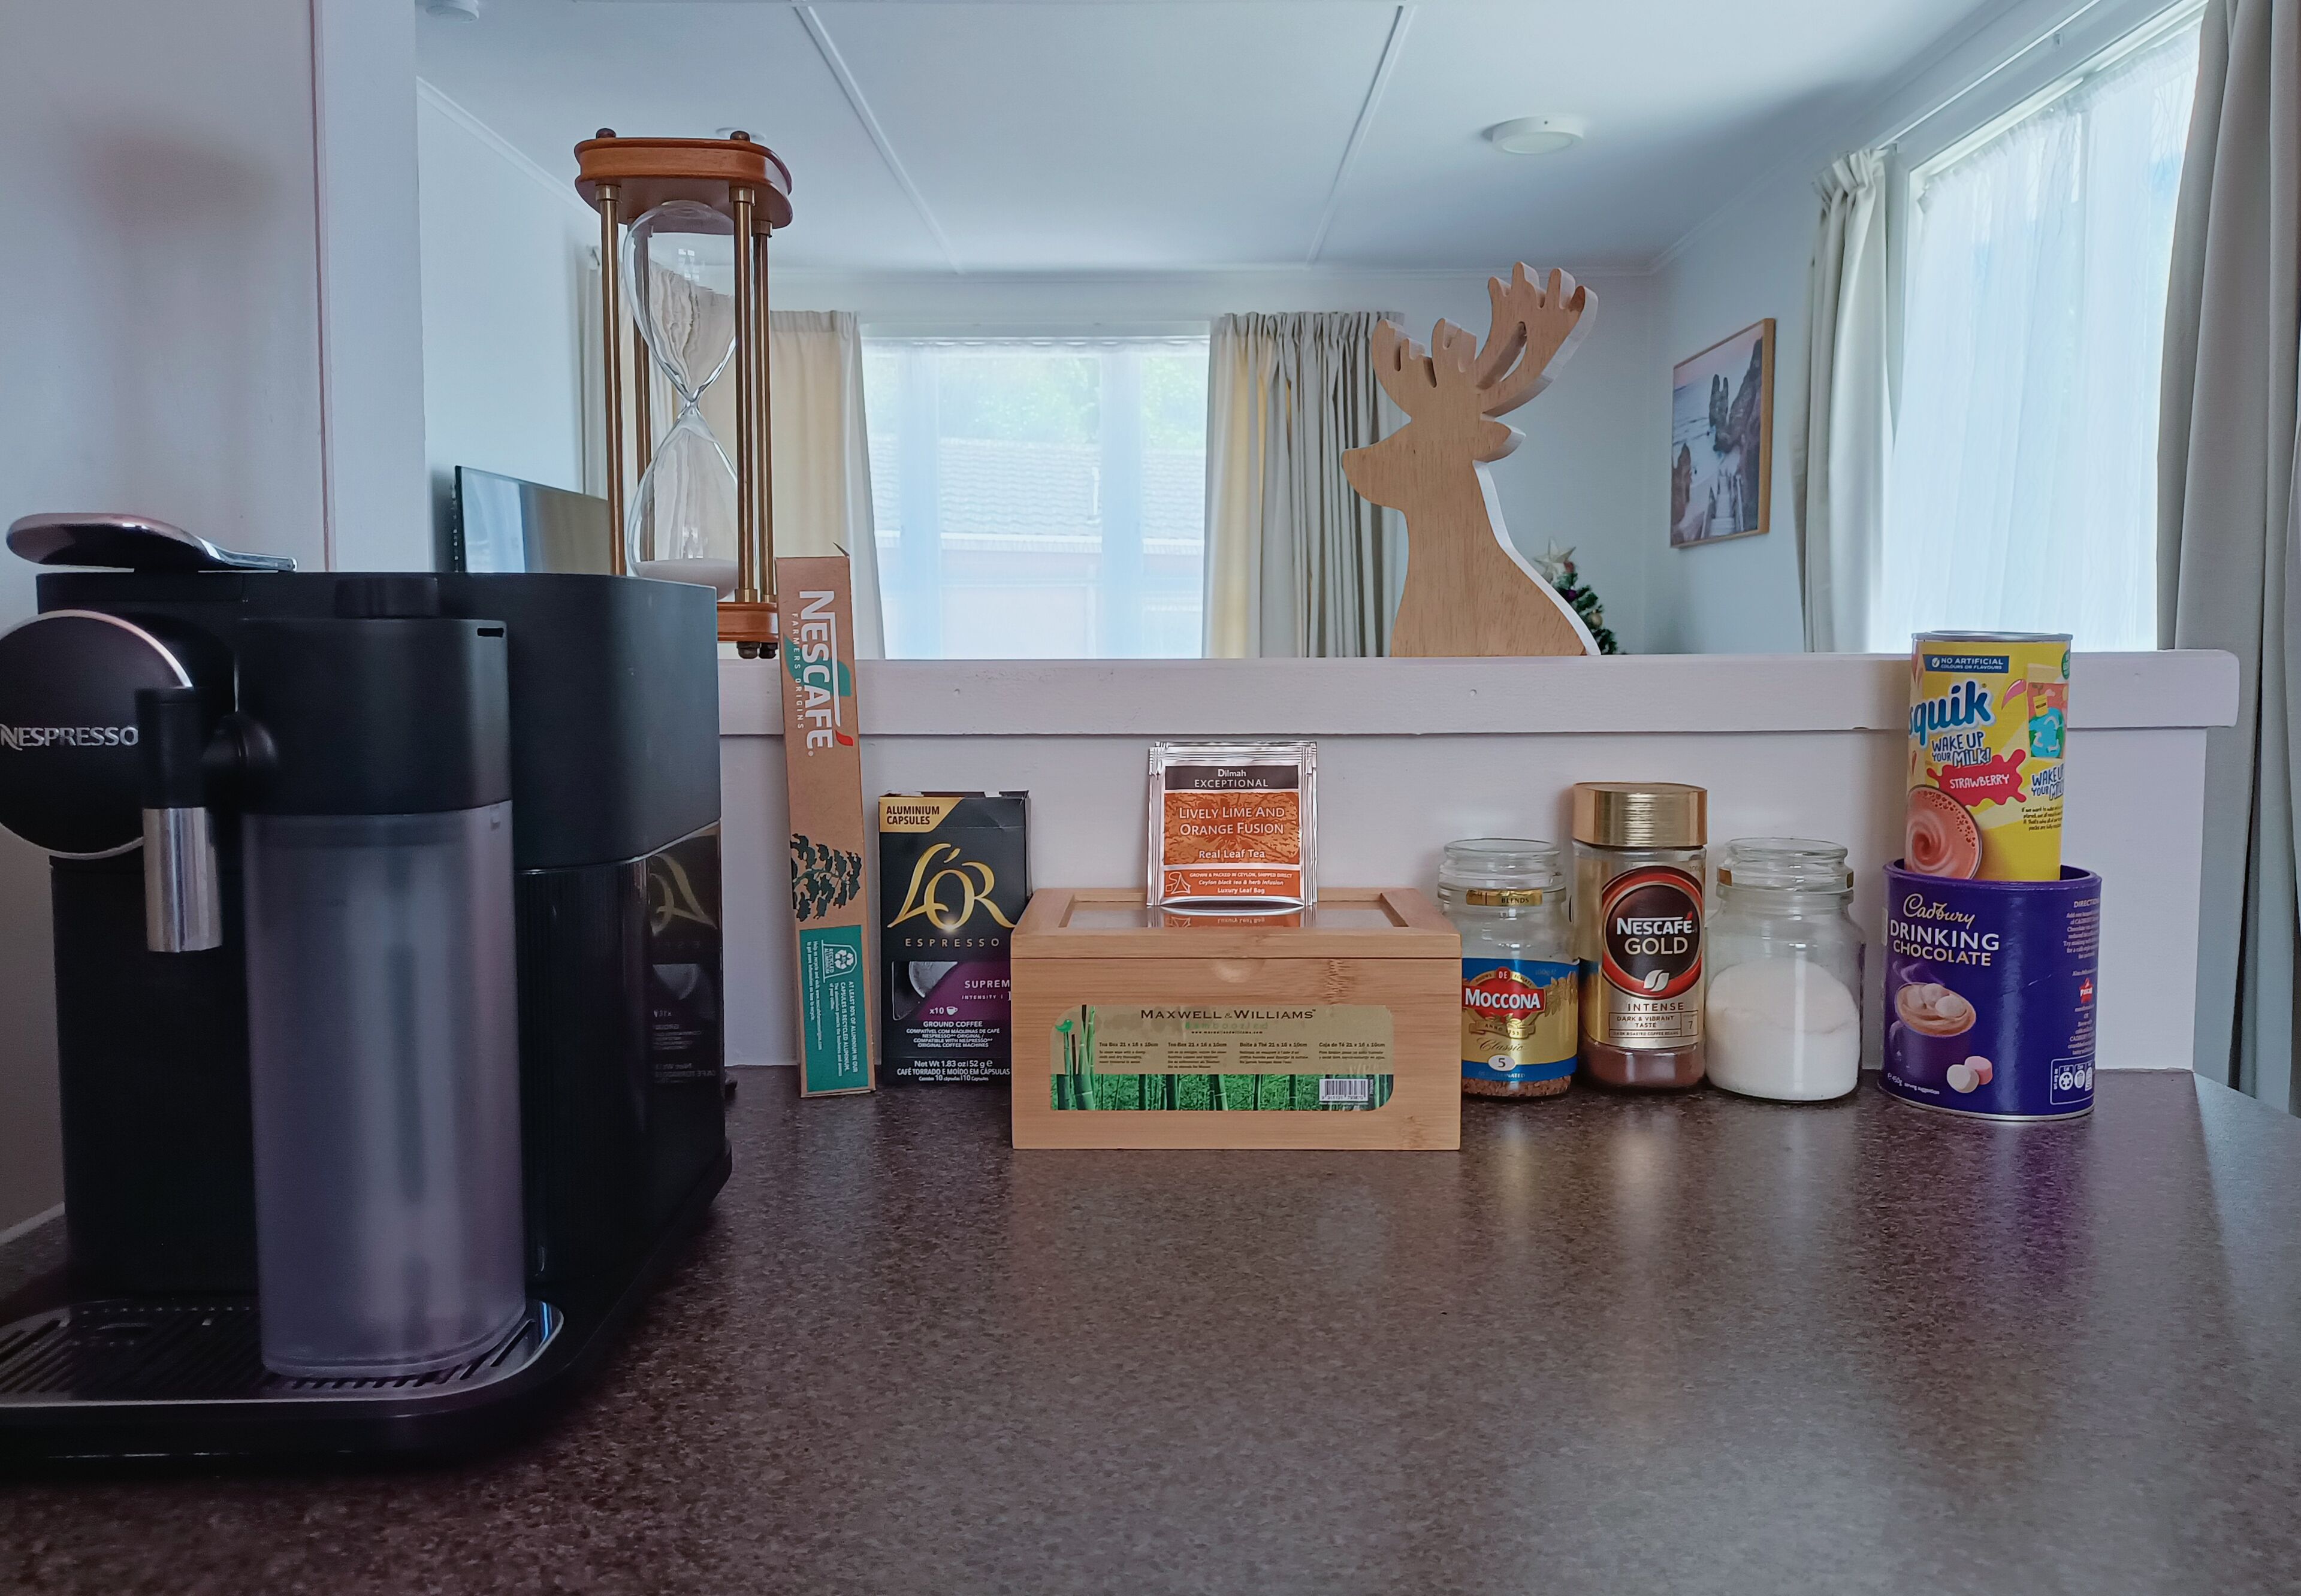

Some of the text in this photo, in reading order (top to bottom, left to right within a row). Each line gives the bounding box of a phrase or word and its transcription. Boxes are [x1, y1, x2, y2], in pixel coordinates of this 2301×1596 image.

[792, 613, 804, 729] FARMERS ORIGINS
[0, 724, 138, 750] NESPRESSO
[1932, 732, 1985, 752] WAKE UP
[1932, 752, 1951, 762] YOUR
[1218, 769, 1246, 777] Dilmah
[2032, 767, 2057, 786] WAKE
[1194, 779, 1269, 788] EXCEPTIONAL
[1949, 773, 2010, 789] STRAWBERRY
[2031, 786, 2049, 796] YOUR
[886, 806, 940, 815] ALUMINIUM
[1179, 806, 1285, 819] LIVELY LIME AND
[886, 815, 930, 825] CAPSULES
[1180, 822, 1284, 836] ORANGE FUSION
[1199, 849, 1266, 859] Real Leaf Tea
[887, 843, 1016, 932] L'OR
[1903, 893, 1975, 930] Cadbury
[1890, 920, 1999, 951] DRINKING
[905, 938, 999, 948] ESPRESSO
[1624, 937, 1688, 955] GOLD
[1893, 939, 1991, 966] CHOCOLATE
[965, 980, 1010, 989] SUPREM
[1465, 987, 1541, 1009] MOCCONA
[1627, 1002, 1684, 1012] INTENSE
[1141, 1010, 1222, 1018] MAXWELL
[1688, 1020, 1693, 1029] 7
[1476, 1037, 1523, 1052] Classic
[1498, 1057, 1506, 1068] 5
[897, 1067, 912, 1075] CAFÉ
[947, 1066, 968, 1075] MOÍDO
